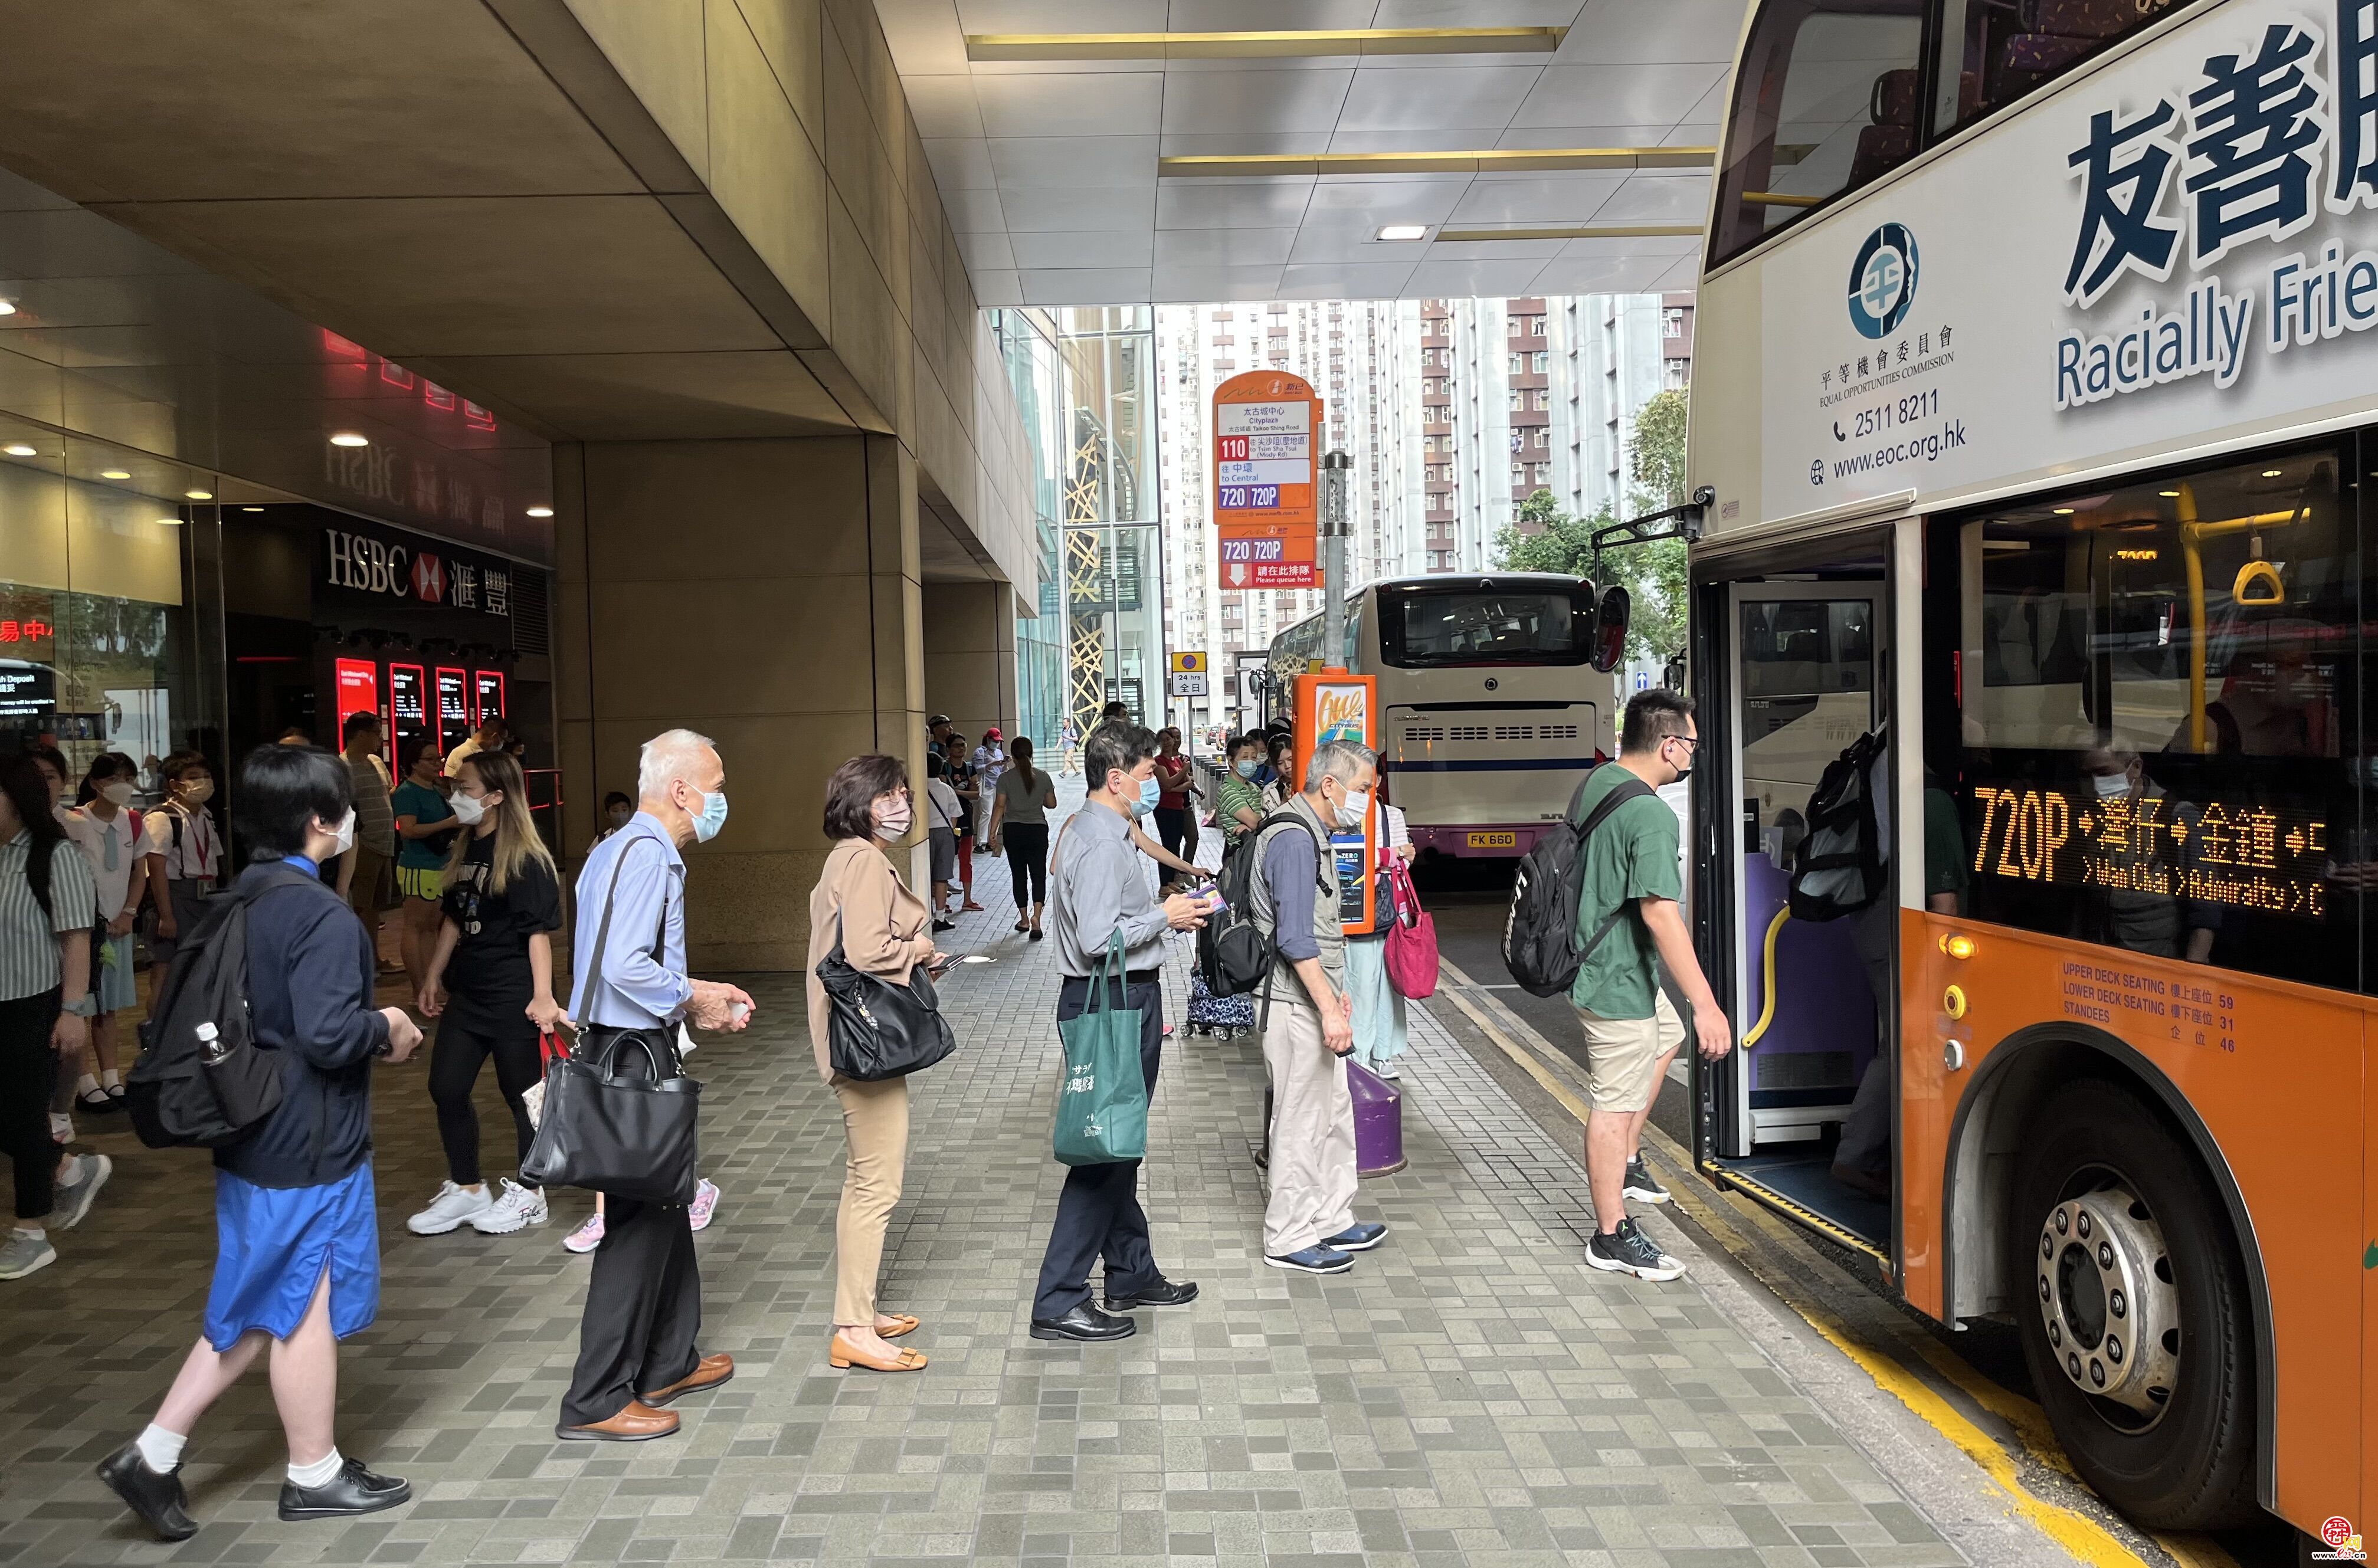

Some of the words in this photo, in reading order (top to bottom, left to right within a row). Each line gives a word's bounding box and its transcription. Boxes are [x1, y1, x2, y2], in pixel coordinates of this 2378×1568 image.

[1820, 324, 1953, 391] 平等機會委員會
[2058, 286, 2248, 402] Racially
[1820, 394, 1843, 408] EQUAL
[1844, 370, 1900, 399] OPPORTUNITIES
[1902, 351, 1954, 378] COMMISSION
[1243, 406, 1285, 416] 太古城中心
[1855, 403, 1892, 438] 2511
[1898, 388, 1938, 424] 8211
[1221, 439, 1246, 458] 110
[1233, 462, 1253, 473] 中環
[1834, 418, 1966, 479] www.eoc.org.hk
[1221, 488, 1245, 506] 720
[1252, 487, 1276, 506] 720P
[1231, 474, 1259, 482] Central
[326, 529, 408, 597] HSBC
[1224, 542, 1249, 560] 720
[1254, 541, 1280, 559] 720P
[1257, 565, 1309, 576] 請在此排隊
[0, 619, 53, 642] 易中
[8, 675, 35, 684] Deposit
[1180, 683, 1200, 693] 全日
[1471, 835, 1485, 844] FK
[1489, 835, 1512, 844] 660
[1975, 787, 2068, 881] 720P
[2097, 796, 2165, 855] 灣仔
[2197, 802, 2277, 869] 金鐘
[2097, 858, 2127, 888] Wan
[2133, 861, 2168, 895] Chai
[2190, 869, 2285, 910] Admiralty
[2063, 962, 2092, 979] UPPER
[2095, 968, 2120, 986] DECK
[2123, 974, 2164, 995] SEATING
[2171, 982, 2213, 1004] 樓上座位
[2219, 995, 2233, 1009] 59
[2064, 982, 2094, 999] LOWER
[2097, 988, 2121, 1006] DECK
[2124, 995, 2164, 1015] SEATING
[2171, 1004, 2213, 1026] 樓下座位
[2220, 1016, 2233, 1032] 31
[2064, 1000, 2110, 1023] STANDEES
[2220, 1038, 2234, 1052] 46
